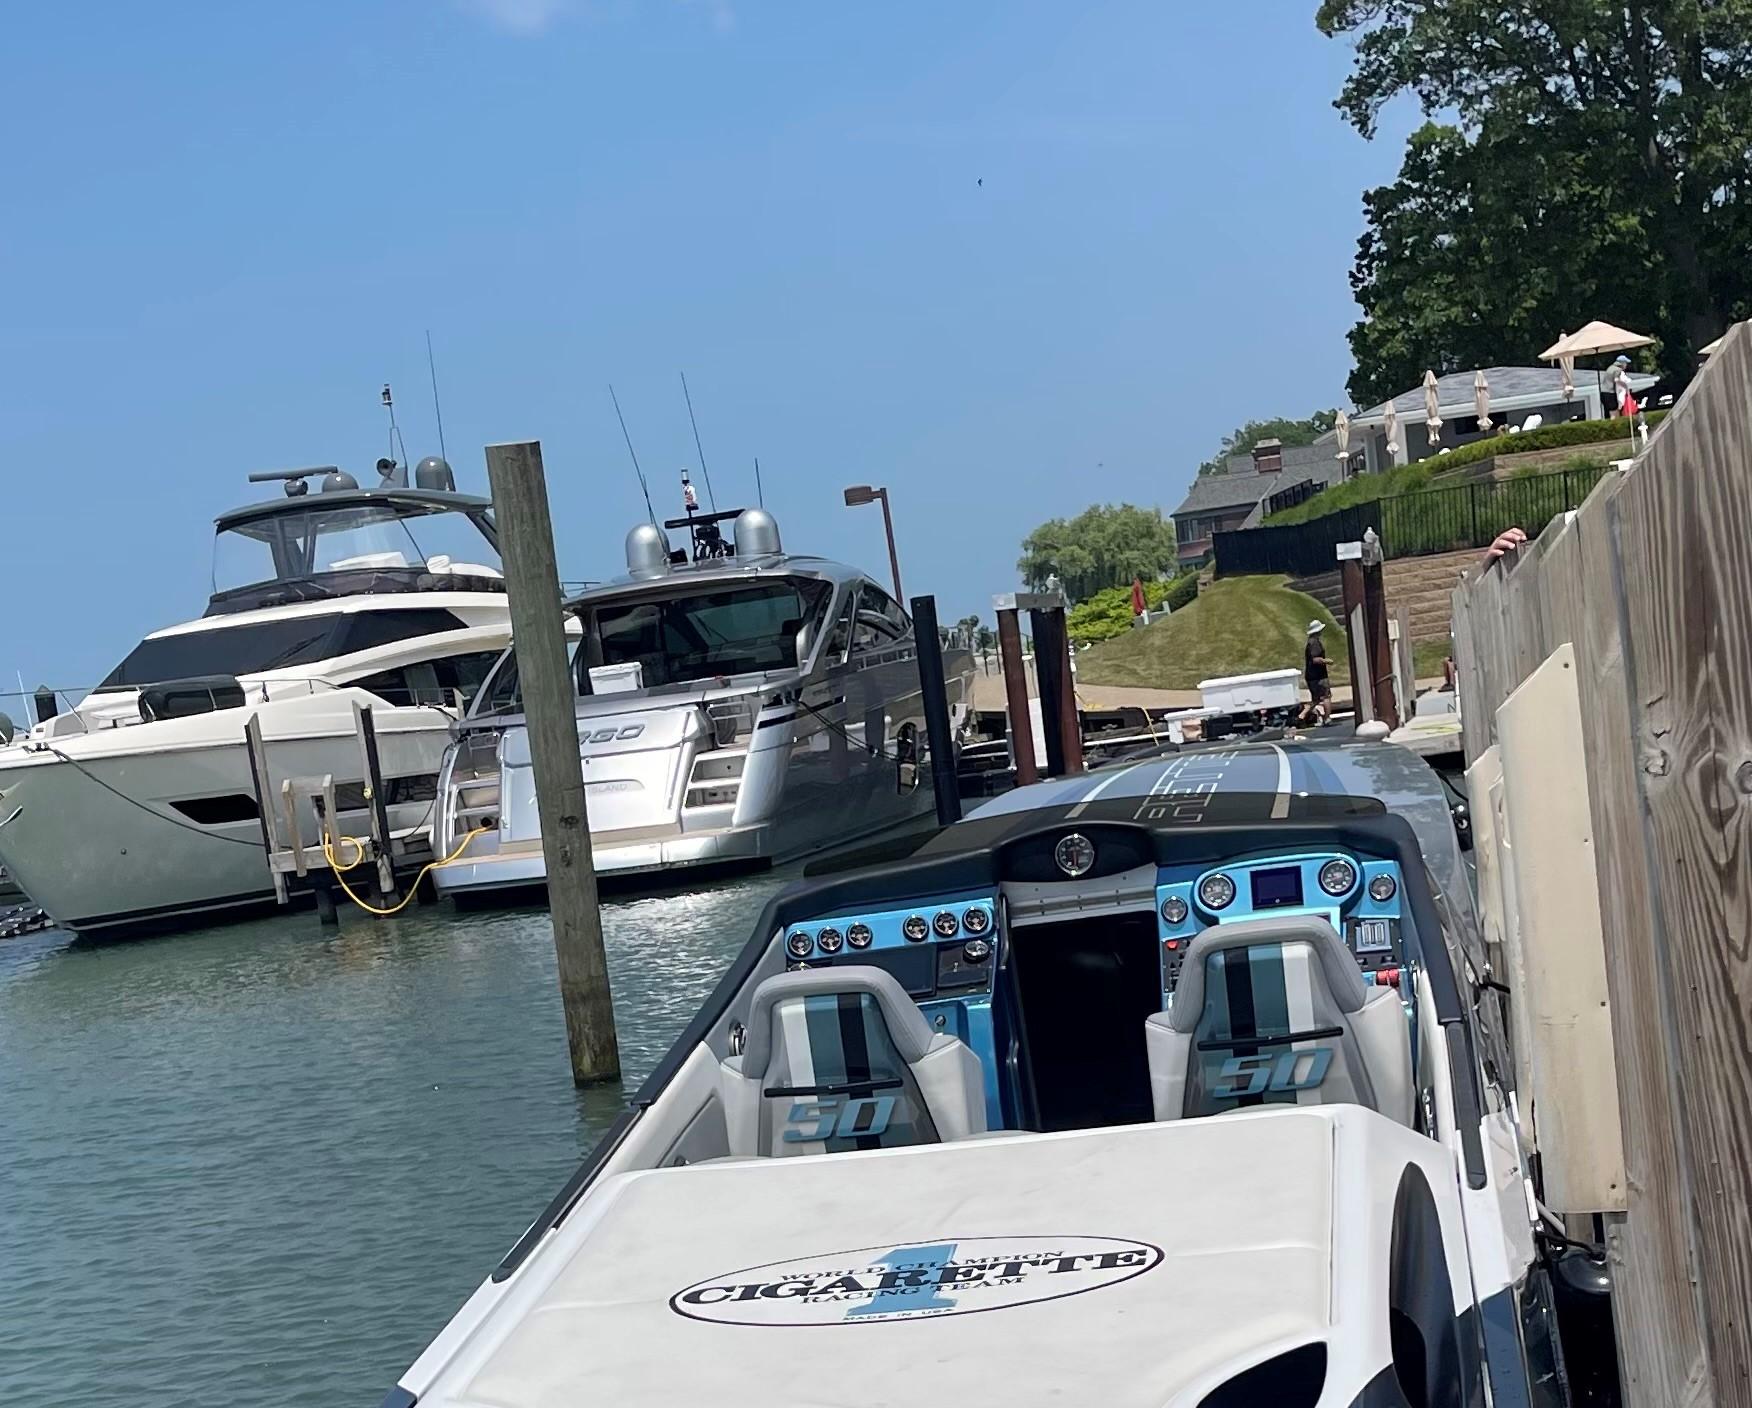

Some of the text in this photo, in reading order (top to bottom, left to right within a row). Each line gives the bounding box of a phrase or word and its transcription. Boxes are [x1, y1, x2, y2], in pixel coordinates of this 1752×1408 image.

[1213, 1048, 1333, 1098] 50
[783, 1096, 895, 1143] 50
[682, 1249, 1148, 1304] CIGARETTE
[780, 1250, 1064, 1281] WORLD CHAMPION
[800, 1277, 1024, 1304] RACING TEAM
